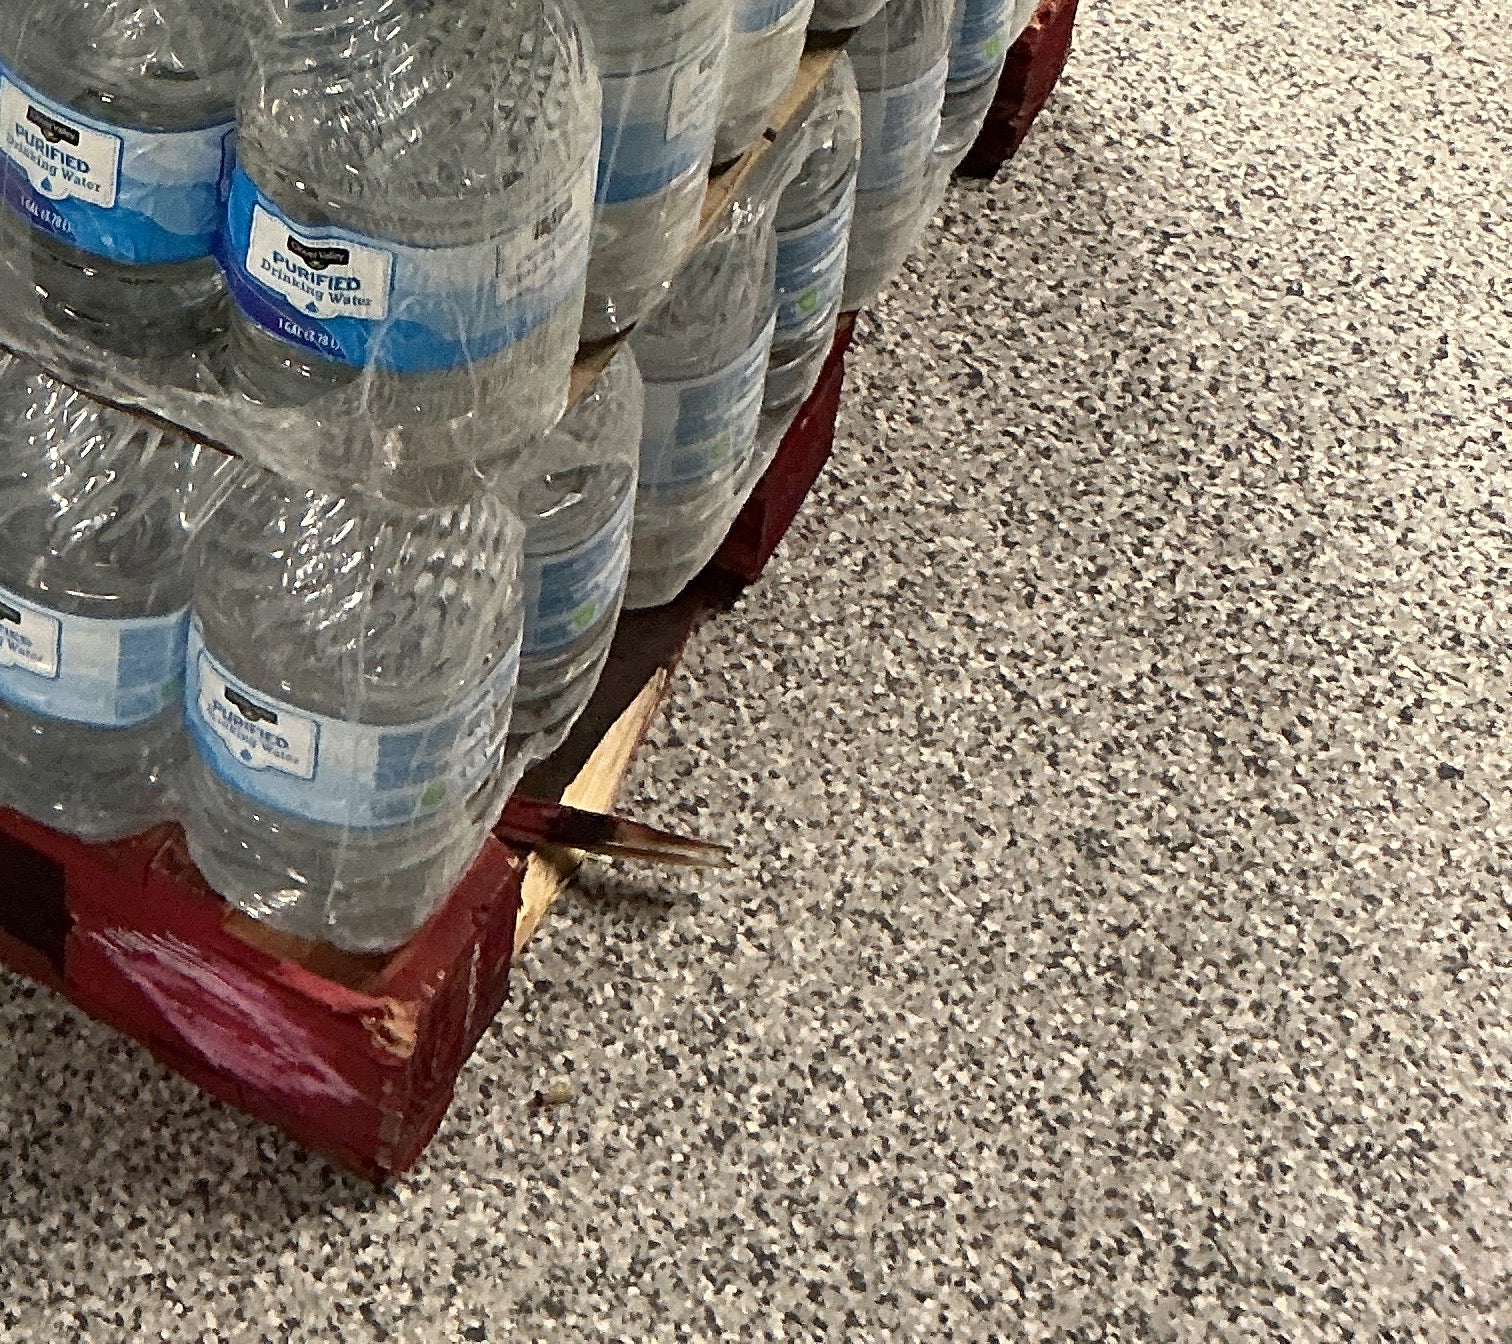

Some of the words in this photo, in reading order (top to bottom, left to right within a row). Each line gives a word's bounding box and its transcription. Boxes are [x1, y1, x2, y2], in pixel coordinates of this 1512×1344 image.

[6, 131, 58, 177] Drinking
[61, 166, 102, 193] Water
[15, 122, 91, 174] PURIFIED
[260, 257, 324, 302] Drinking
[329, 290, 373, 308] Water
[273, 249, 361, 291] PURIFIED
